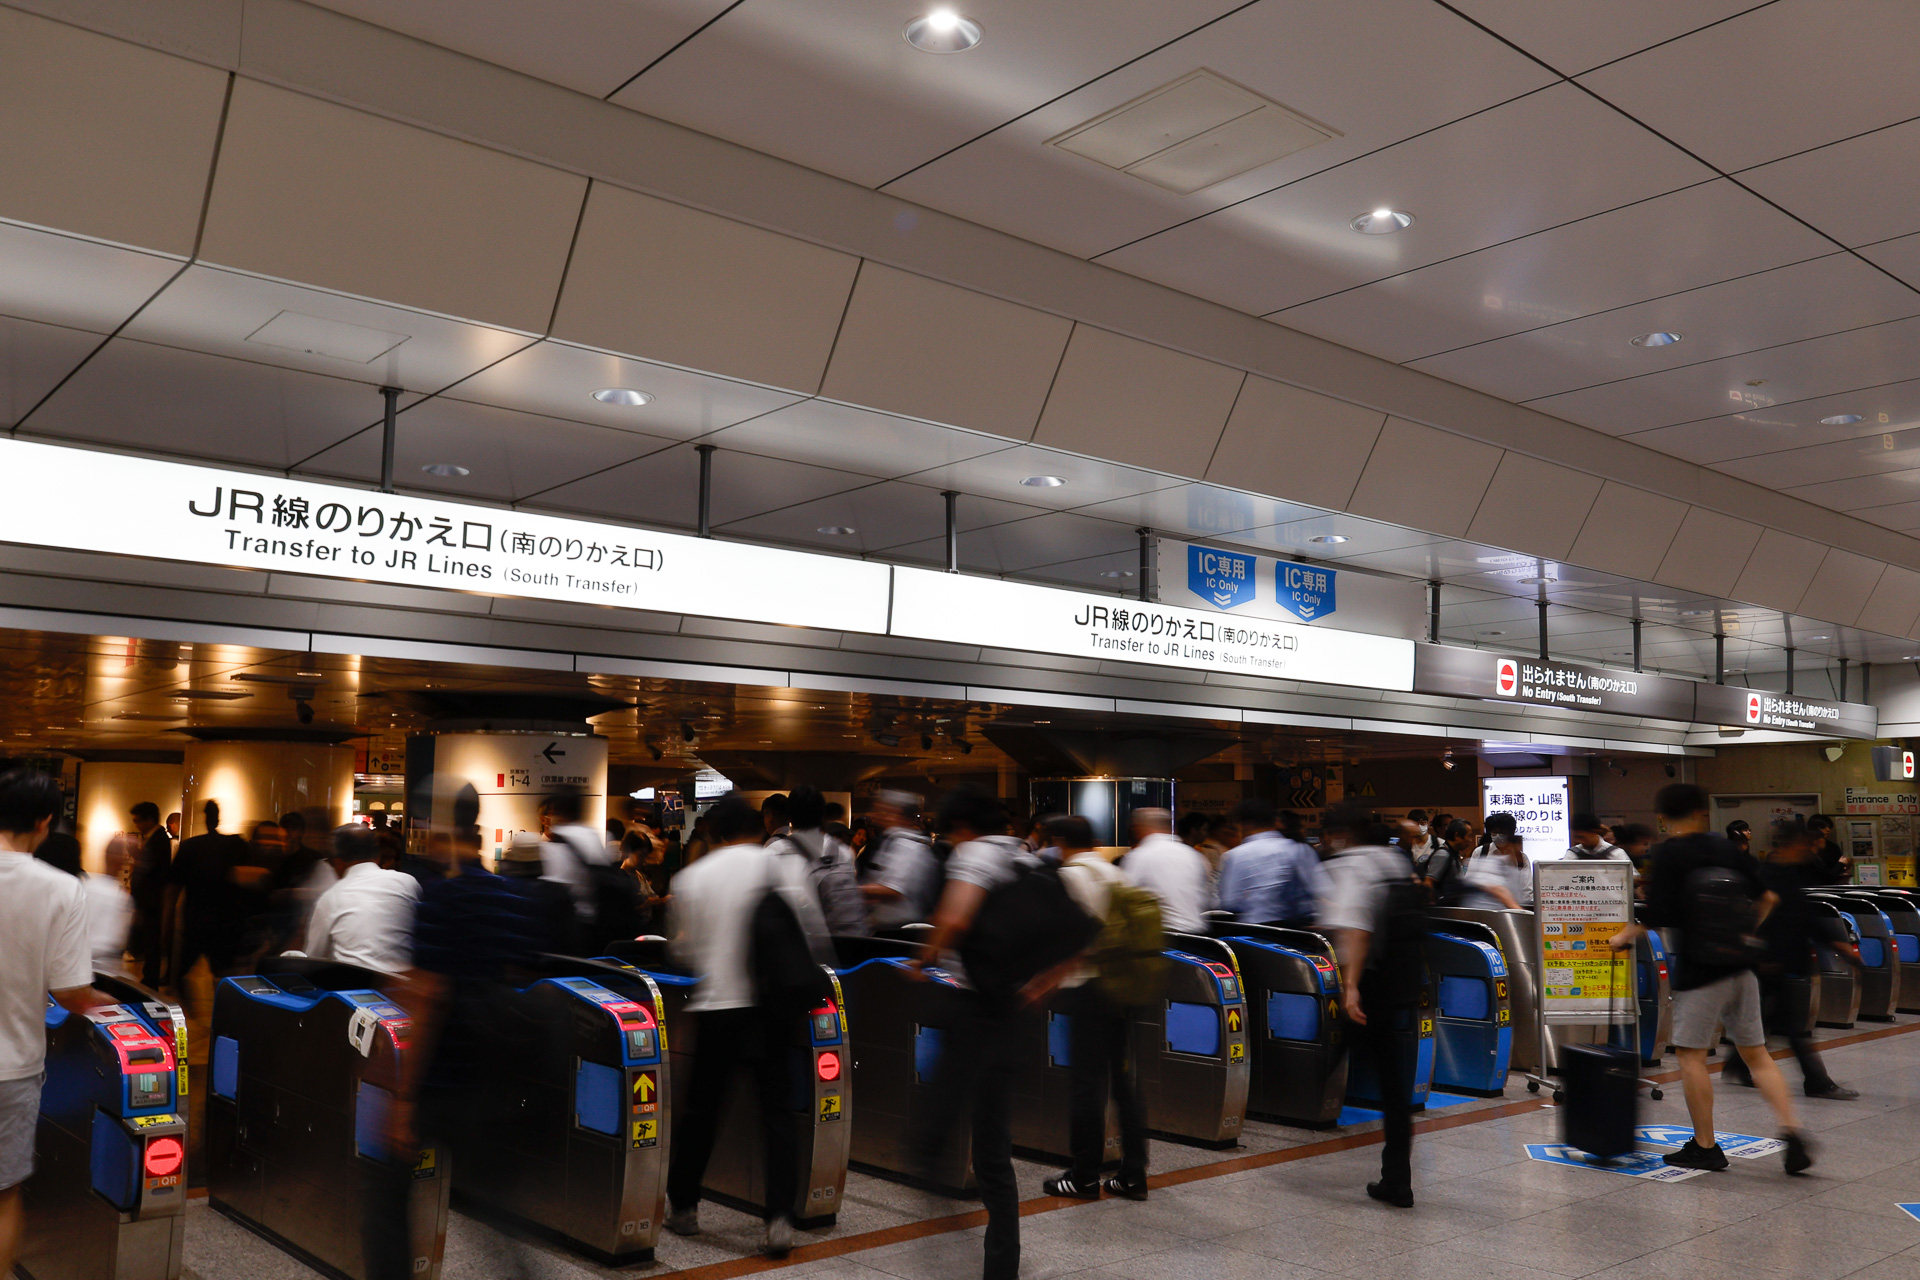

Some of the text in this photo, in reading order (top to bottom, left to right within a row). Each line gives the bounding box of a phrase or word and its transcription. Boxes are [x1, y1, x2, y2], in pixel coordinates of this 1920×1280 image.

[224, 529, 638, 596] Transfer to JR Lines (South Transfer)
[1198, 551, 1246, 581] IC専用
[1206, 577, 1239, 594] IC Only
[1284, 566, 1327, 594] IC専用
[1292, 591, 1321, 607] IC Only
[1090, 633, 1287, 670] Transfer to JR Lines (South Transfer)
[1522, 684, 1602, 706] No Entry (South Transfer)
[1763, 713, 1771, 724] No
[1772, 715, 1786, 728] Entry
[662, 799, 684, 812] 入口
[1489, 793, 1563, 806] 東海道・山陽
[1846, 794, 1917, 804] Entrance Only
[1490, 810, 1563, 822] 線のりば
[1571, 875, 1595, 884] ご案内
[1488, 952, 1502, 966] IC
[1496, 982, 1507, 998] IC
[643, 1103, 655, 1112] QR
[161, 1175, 177, 1186] QR
[624, 1221, 649, 1233] 17 16
[416, 1260, 426, 1270] 17
